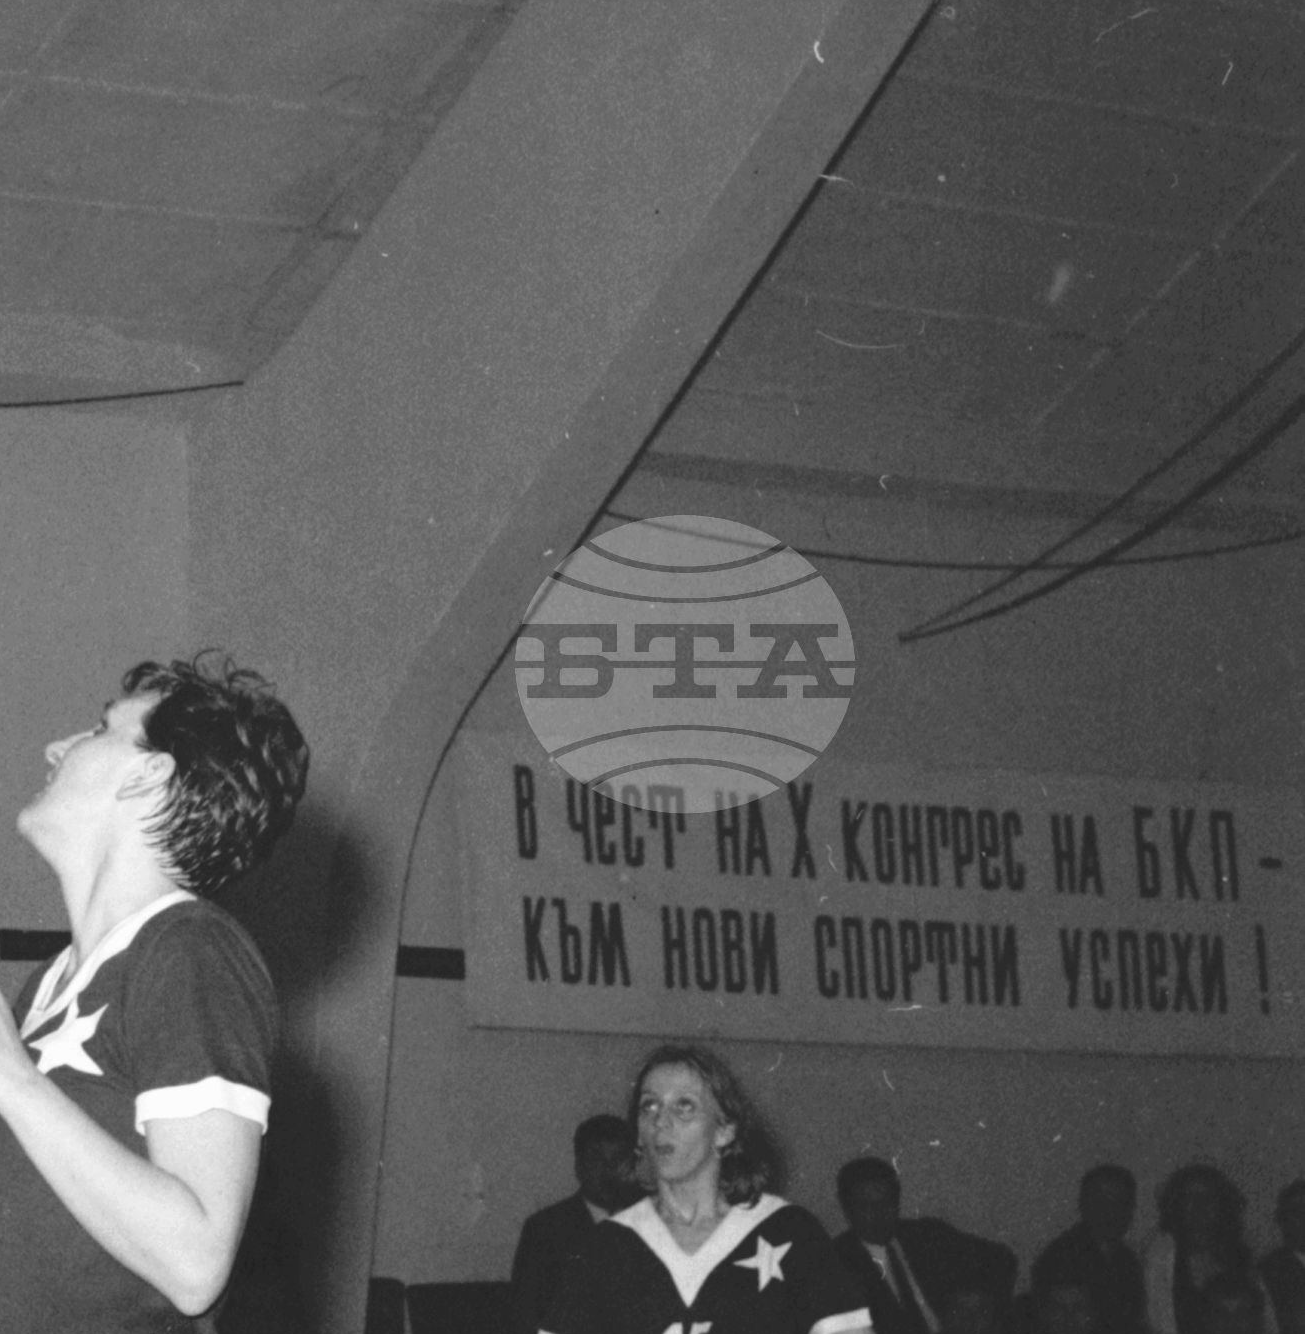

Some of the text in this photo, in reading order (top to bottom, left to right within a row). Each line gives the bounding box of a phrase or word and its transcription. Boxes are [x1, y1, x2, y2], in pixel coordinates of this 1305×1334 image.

[513, 764, 538, 860] В
[715, 788, 771, 877] НА
[1050, 812, 1105, 897] НА
[1133, 804, 1240, 902] БКП
[523, 895, 631, 987] КЪМ
[661, 904, 779, 996] НОВИ
[813, 913, 1021, 1008] СПОРТНИ
